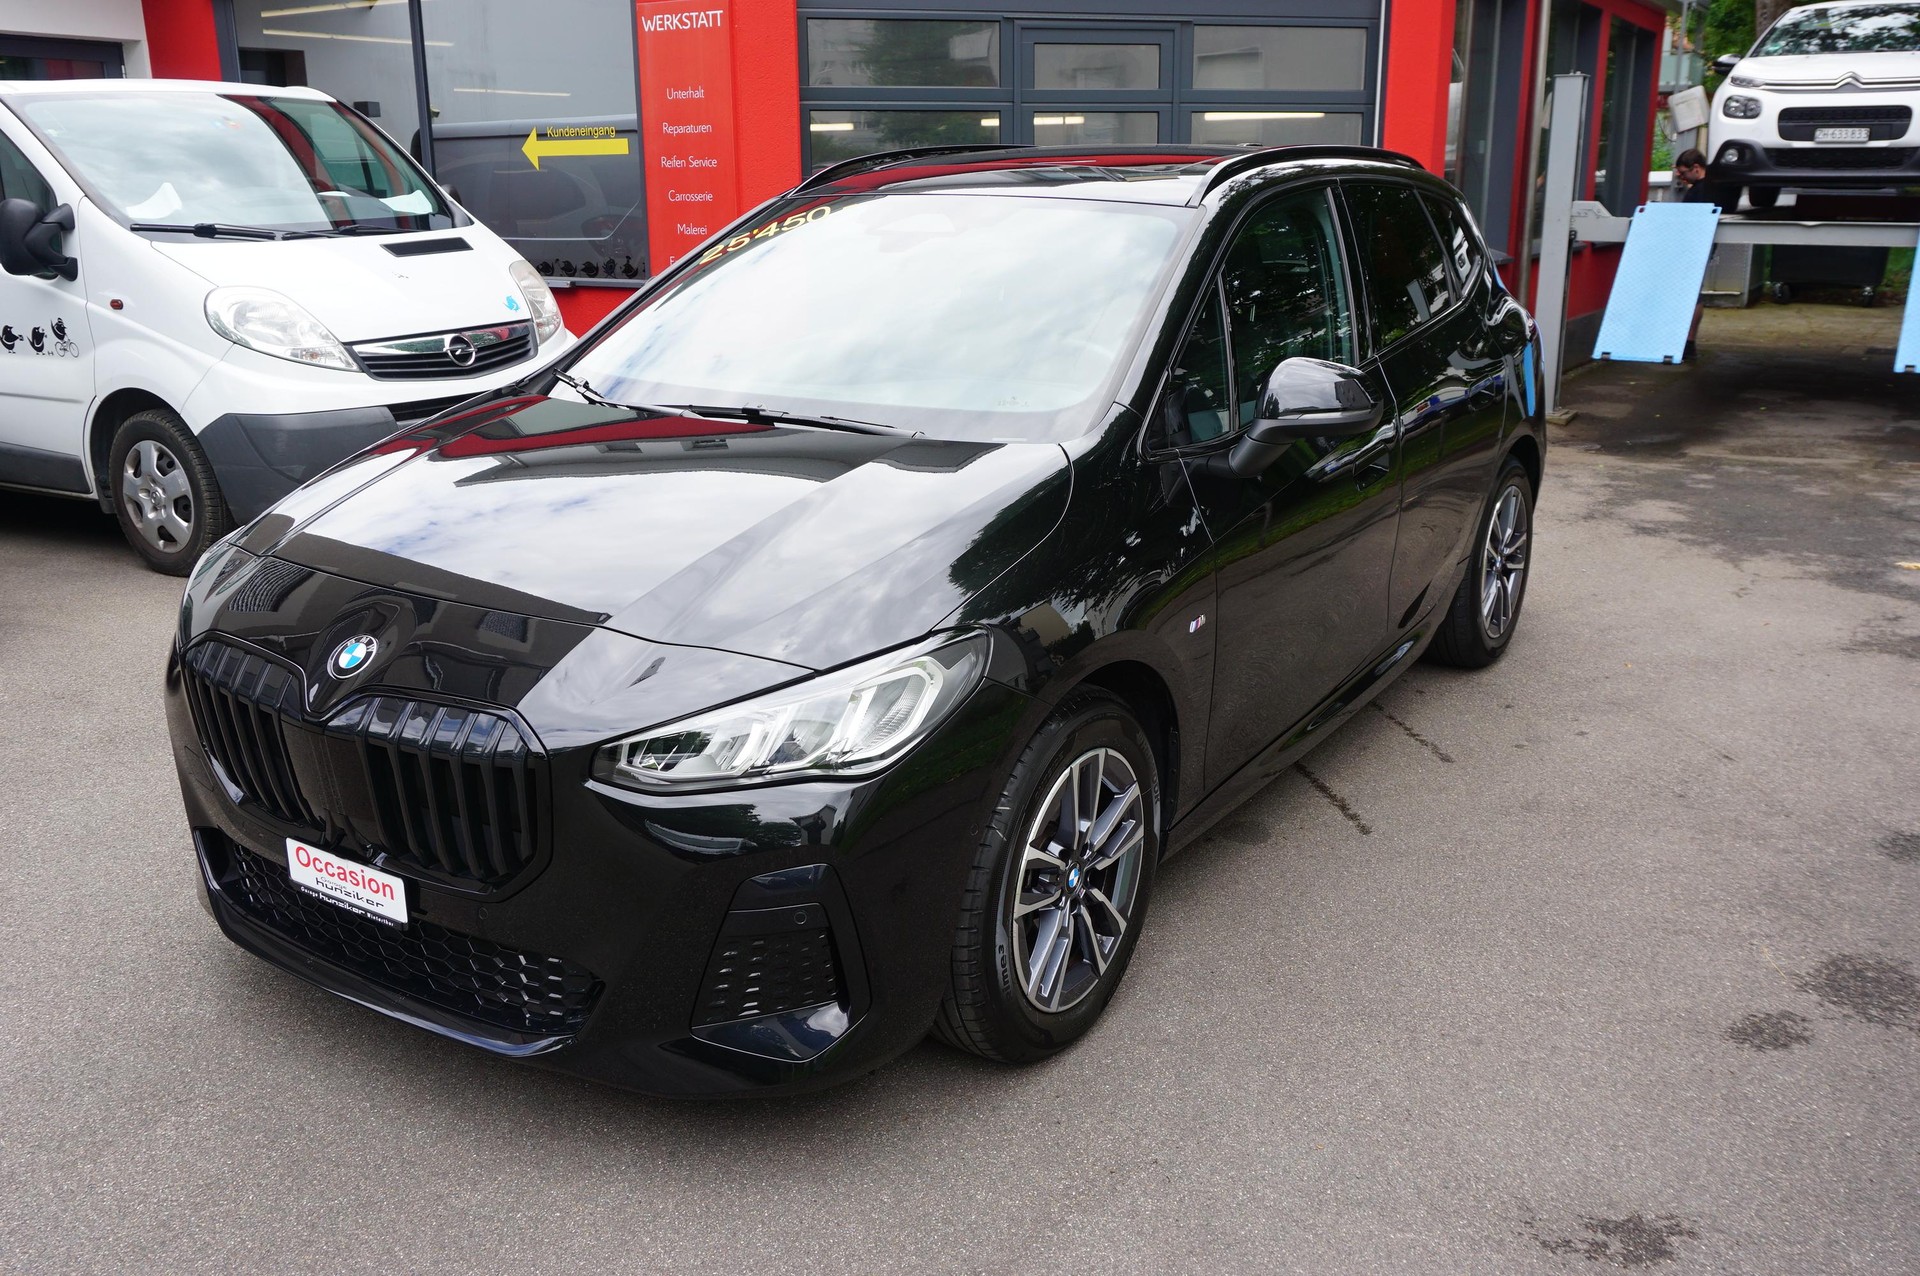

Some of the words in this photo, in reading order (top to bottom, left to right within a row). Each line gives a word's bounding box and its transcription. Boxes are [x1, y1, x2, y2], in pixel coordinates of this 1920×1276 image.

[641, 10, 723, 32] WERKSTATT
[666, 86, 705, 100] Unterhalt
[547, 125, 616, 138] Kundeneingang
[662, 122, 712, 137] Reparaturen
[660, 156, 686, 168] Reifen
[688, 156, 718, 168] Service
[668, 190, 713, 202] Carrosserie
[677, 223, 708, 235] Malerei
[295, 846, 395, 901] Occasion
[315, 877, 385, 908] hunziker
[319, 892, 366, 915] hunziker
